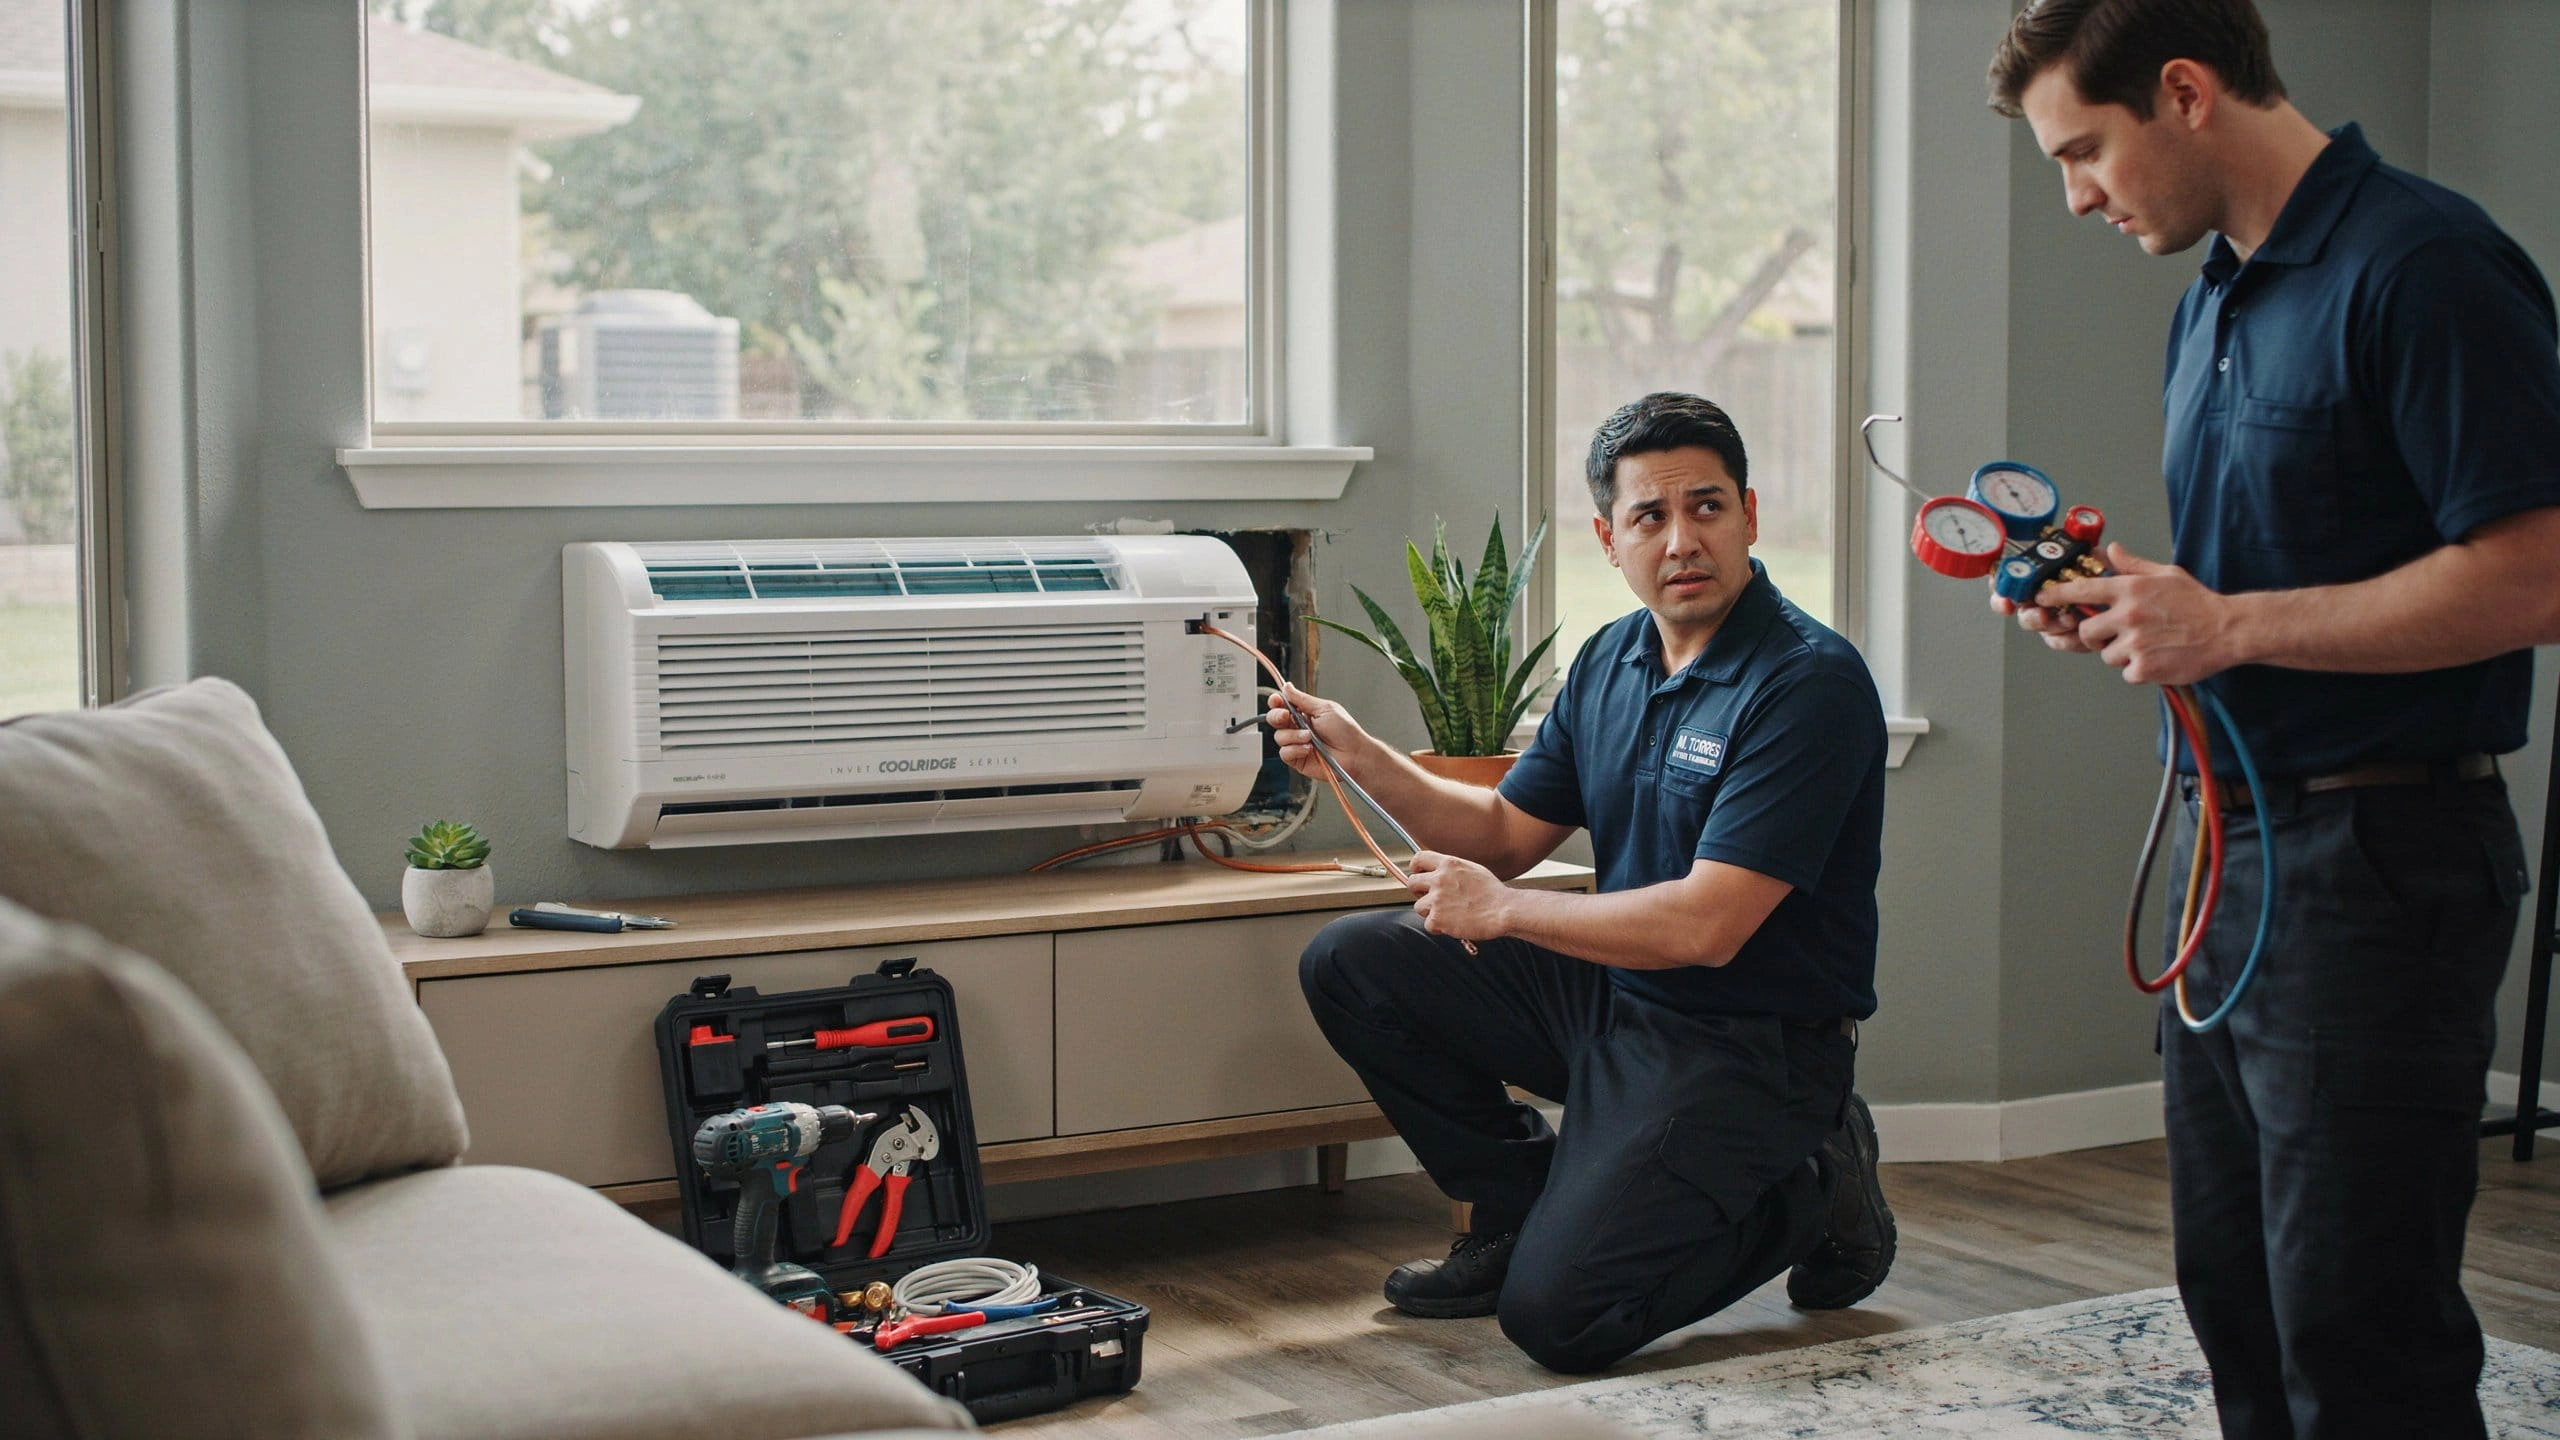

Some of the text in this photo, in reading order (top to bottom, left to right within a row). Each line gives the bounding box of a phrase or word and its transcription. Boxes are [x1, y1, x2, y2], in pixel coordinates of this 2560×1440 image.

[1689, 737, 1721, 758] TORRES
[878, 757, 957, 773] COOLRIDGE
[969, 756, 1017, 766] SERIES
